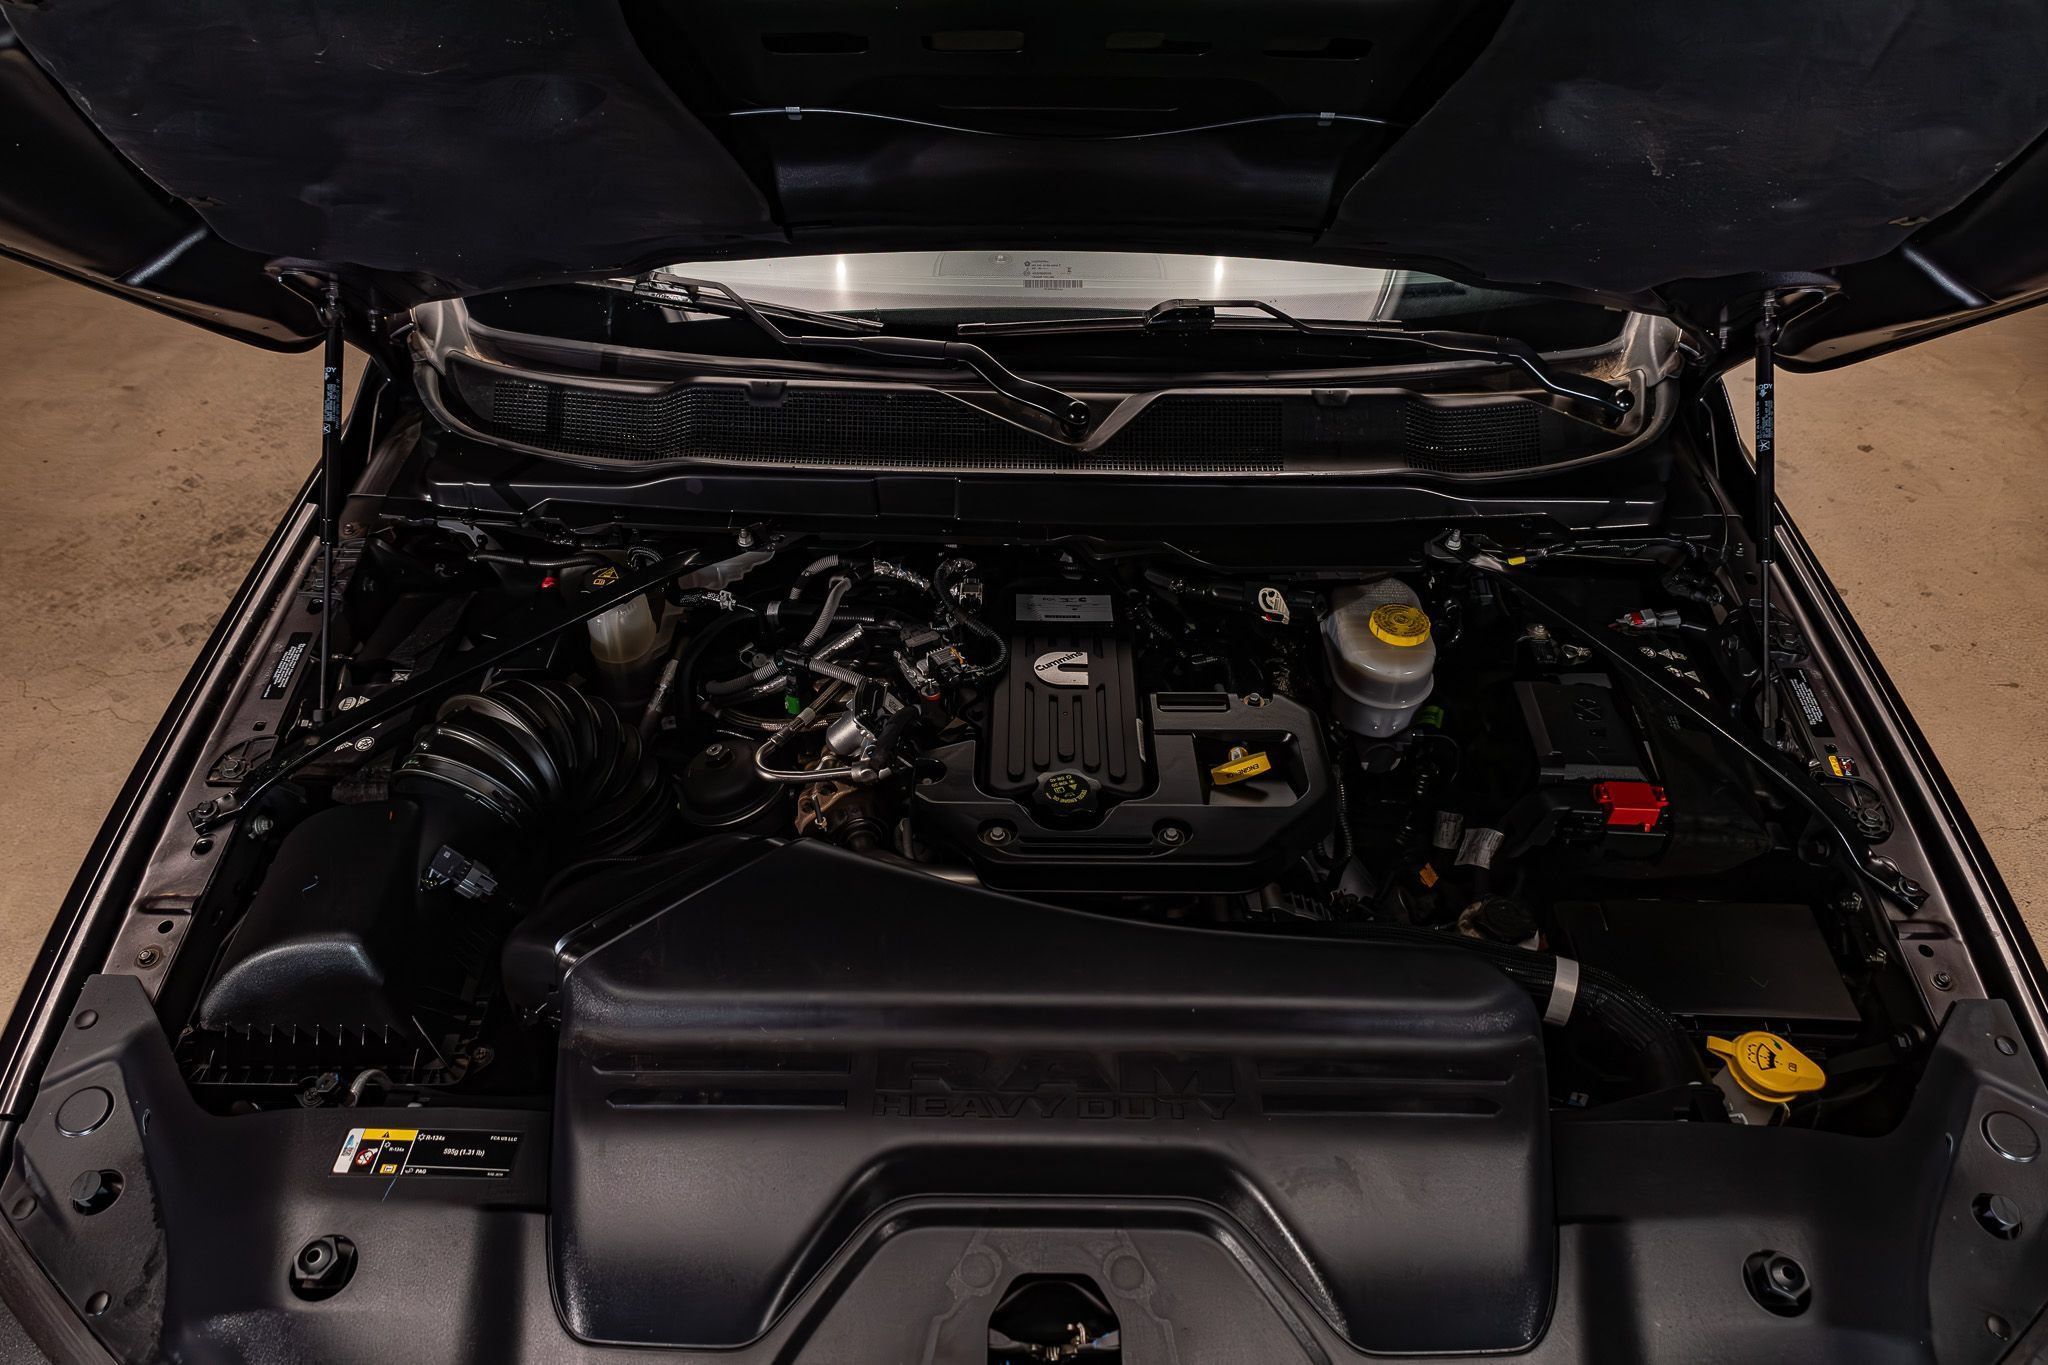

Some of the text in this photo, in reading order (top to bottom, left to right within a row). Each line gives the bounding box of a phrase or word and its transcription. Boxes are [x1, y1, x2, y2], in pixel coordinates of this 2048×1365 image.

[1035, 652, 1083, 671] Cummins
[1237, 763, 1260, 776] ENGINE
[875, 1050, 1236, 1094] RAM
[873, 1092, 1236, 1120] HEAVY DUTY
[443, 1148, 485, 1157] 595g (1.31 lb)
